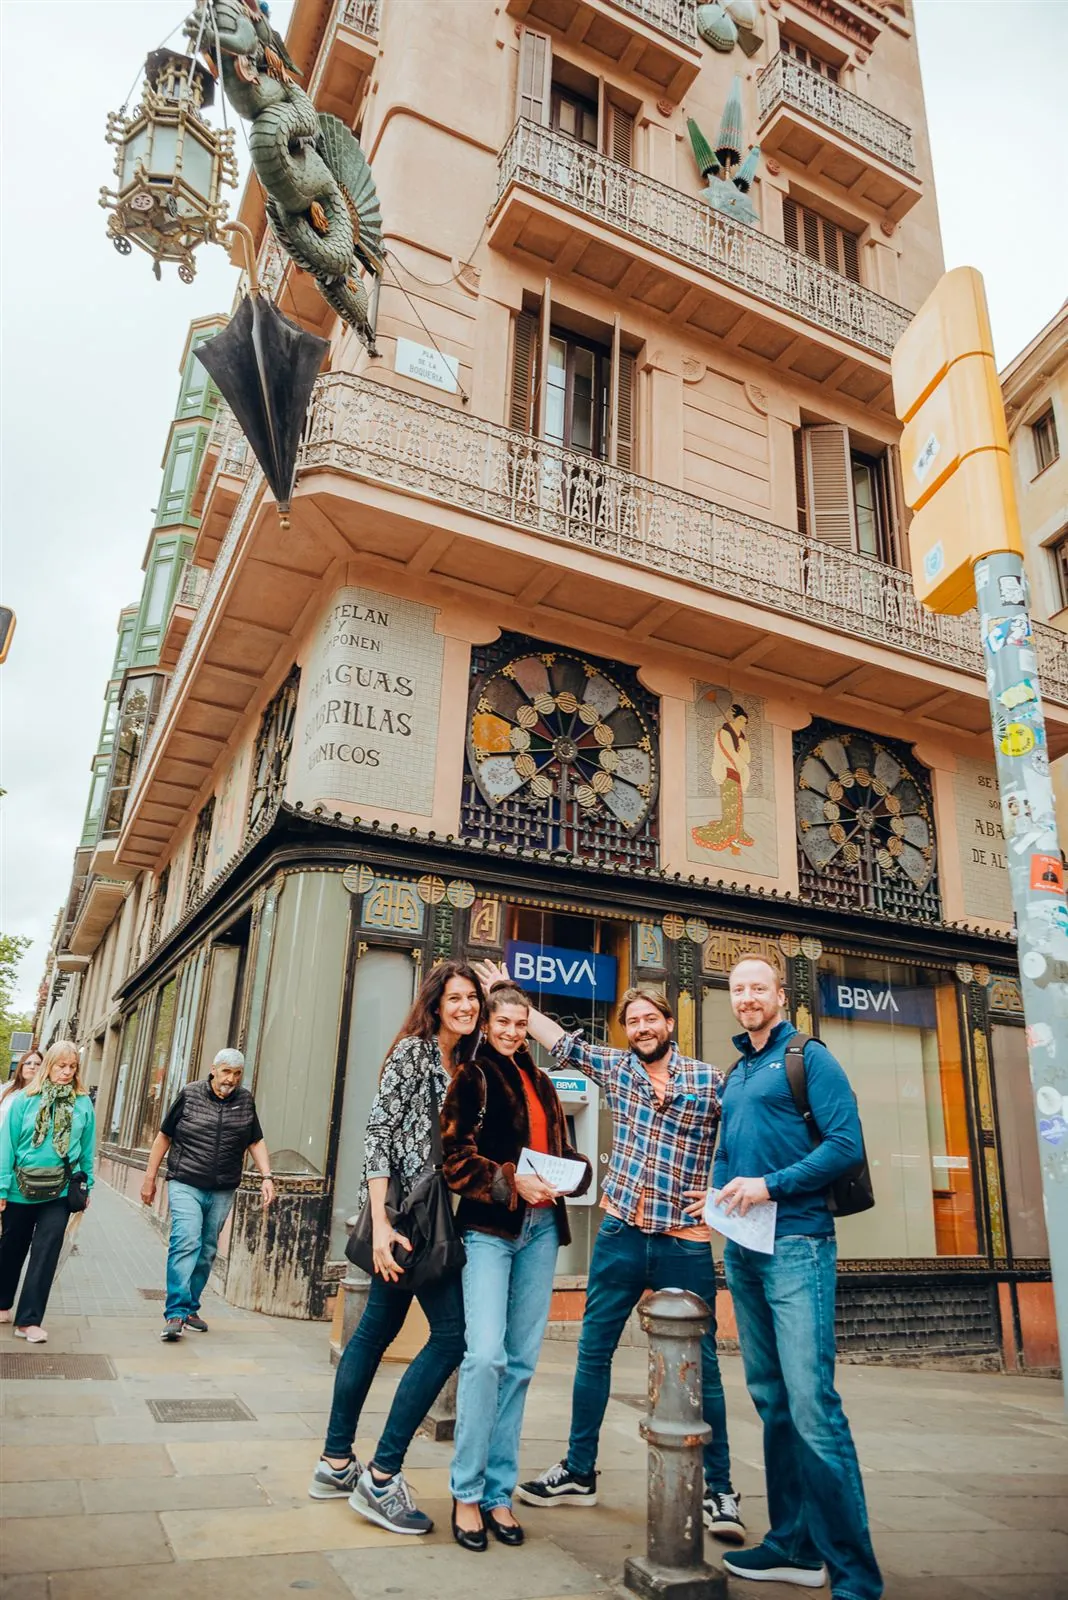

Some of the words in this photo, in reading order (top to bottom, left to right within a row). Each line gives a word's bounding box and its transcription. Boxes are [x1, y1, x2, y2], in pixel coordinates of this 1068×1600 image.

[423, 351, 434, 360] PLA
[977, 775, 992, 788] SE
[971, 848, 987, 865] DE
[514, 952, 597, 986] BBVA
[837, 985, 900, 1012] BBVA
[555, 1081, 578, 1090] BBVA
